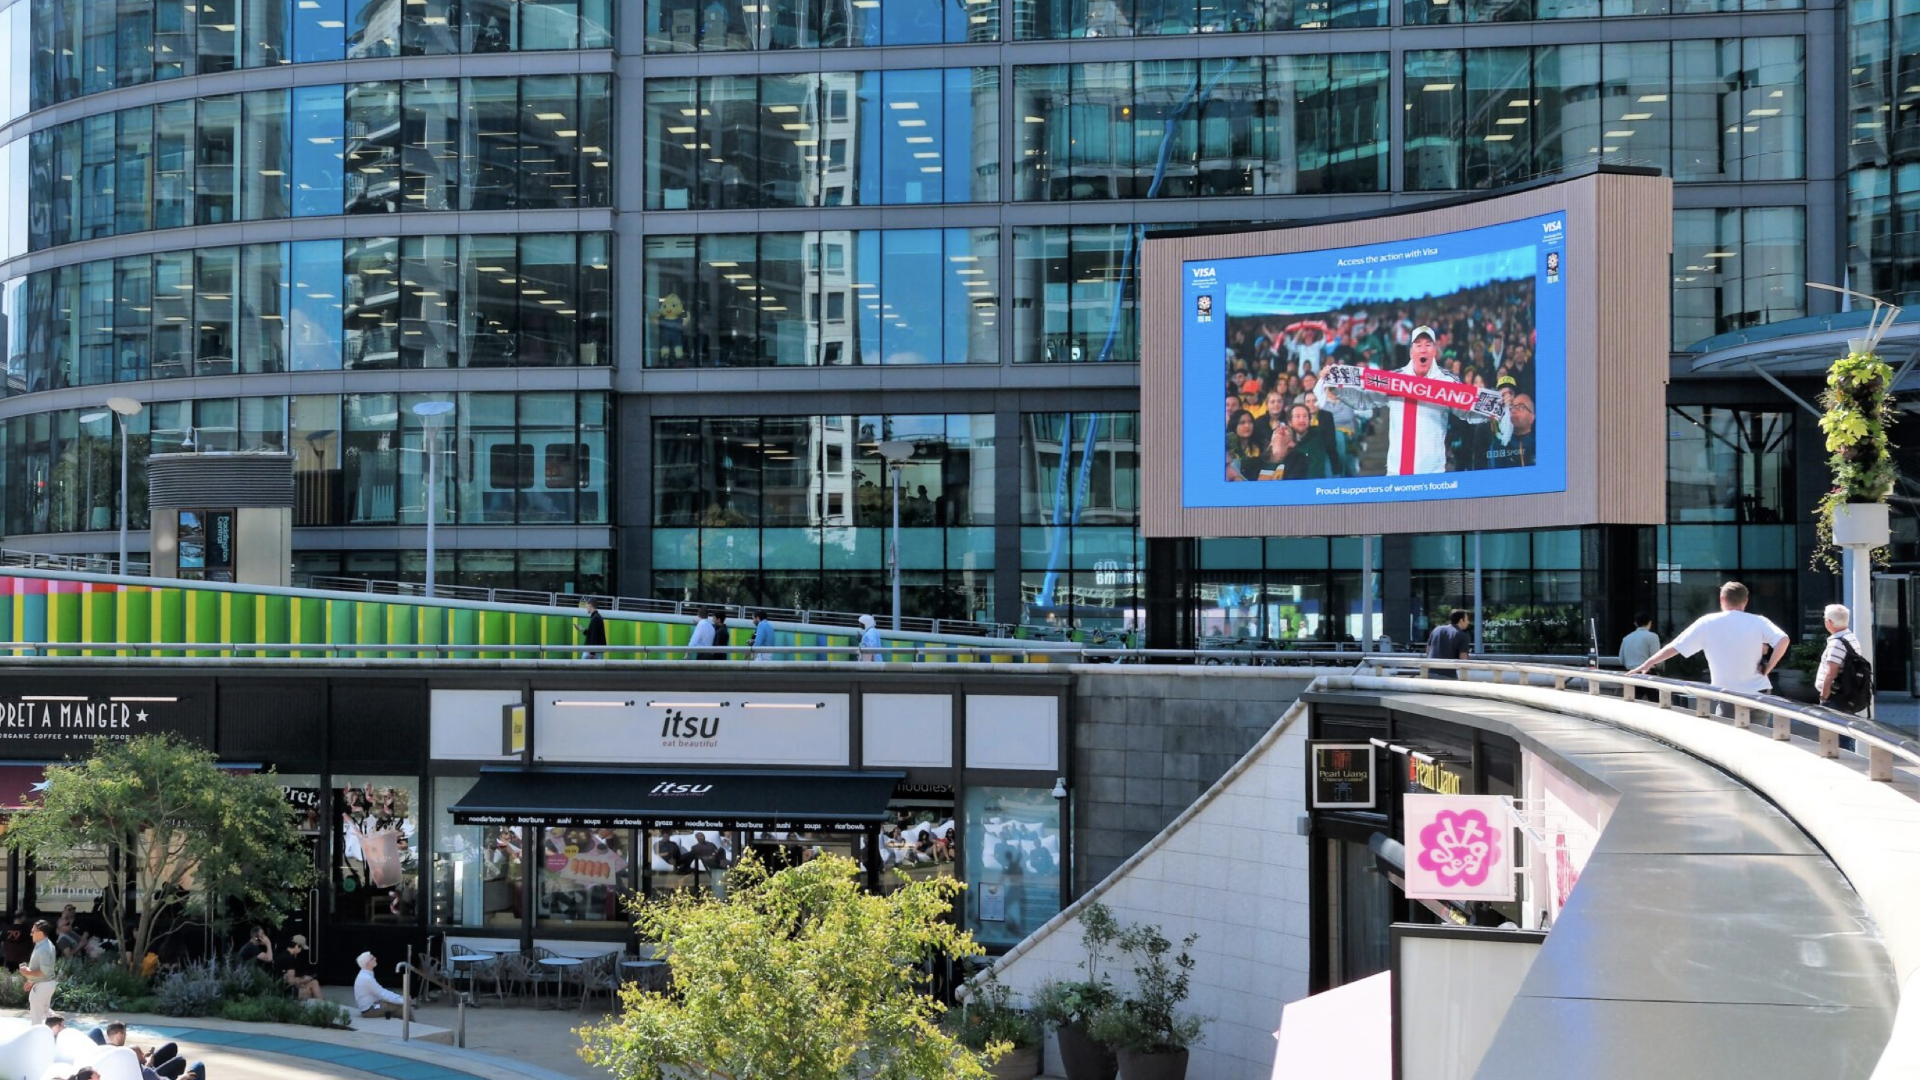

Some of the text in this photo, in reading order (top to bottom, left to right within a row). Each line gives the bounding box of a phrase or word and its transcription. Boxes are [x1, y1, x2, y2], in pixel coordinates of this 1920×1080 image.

[1542, 220, 1562, 233] VISA
[1337, 247, 1438, 267] Access the action with Visa
[1191, 267, 1216, 278] VISA
[1391, 378, 1474, 406] ENGLAND
[1315, 480, 1459, 496] Proud supporters of women's football
[0, 702, 130, 728] PRET A MANGER
[661, 708, 720, 739] itsu
[678, 739, 718, 747] beautiful
[1319, 770, 1368, 780] Pearl Liang
[650, 781, 714, 794] itsu
[583, 818, 601, 826] soups
[654, 819, 673, 827] gyoza
[776, 821, 791, 829] sushi
[804, 822, 821, 831] soups
